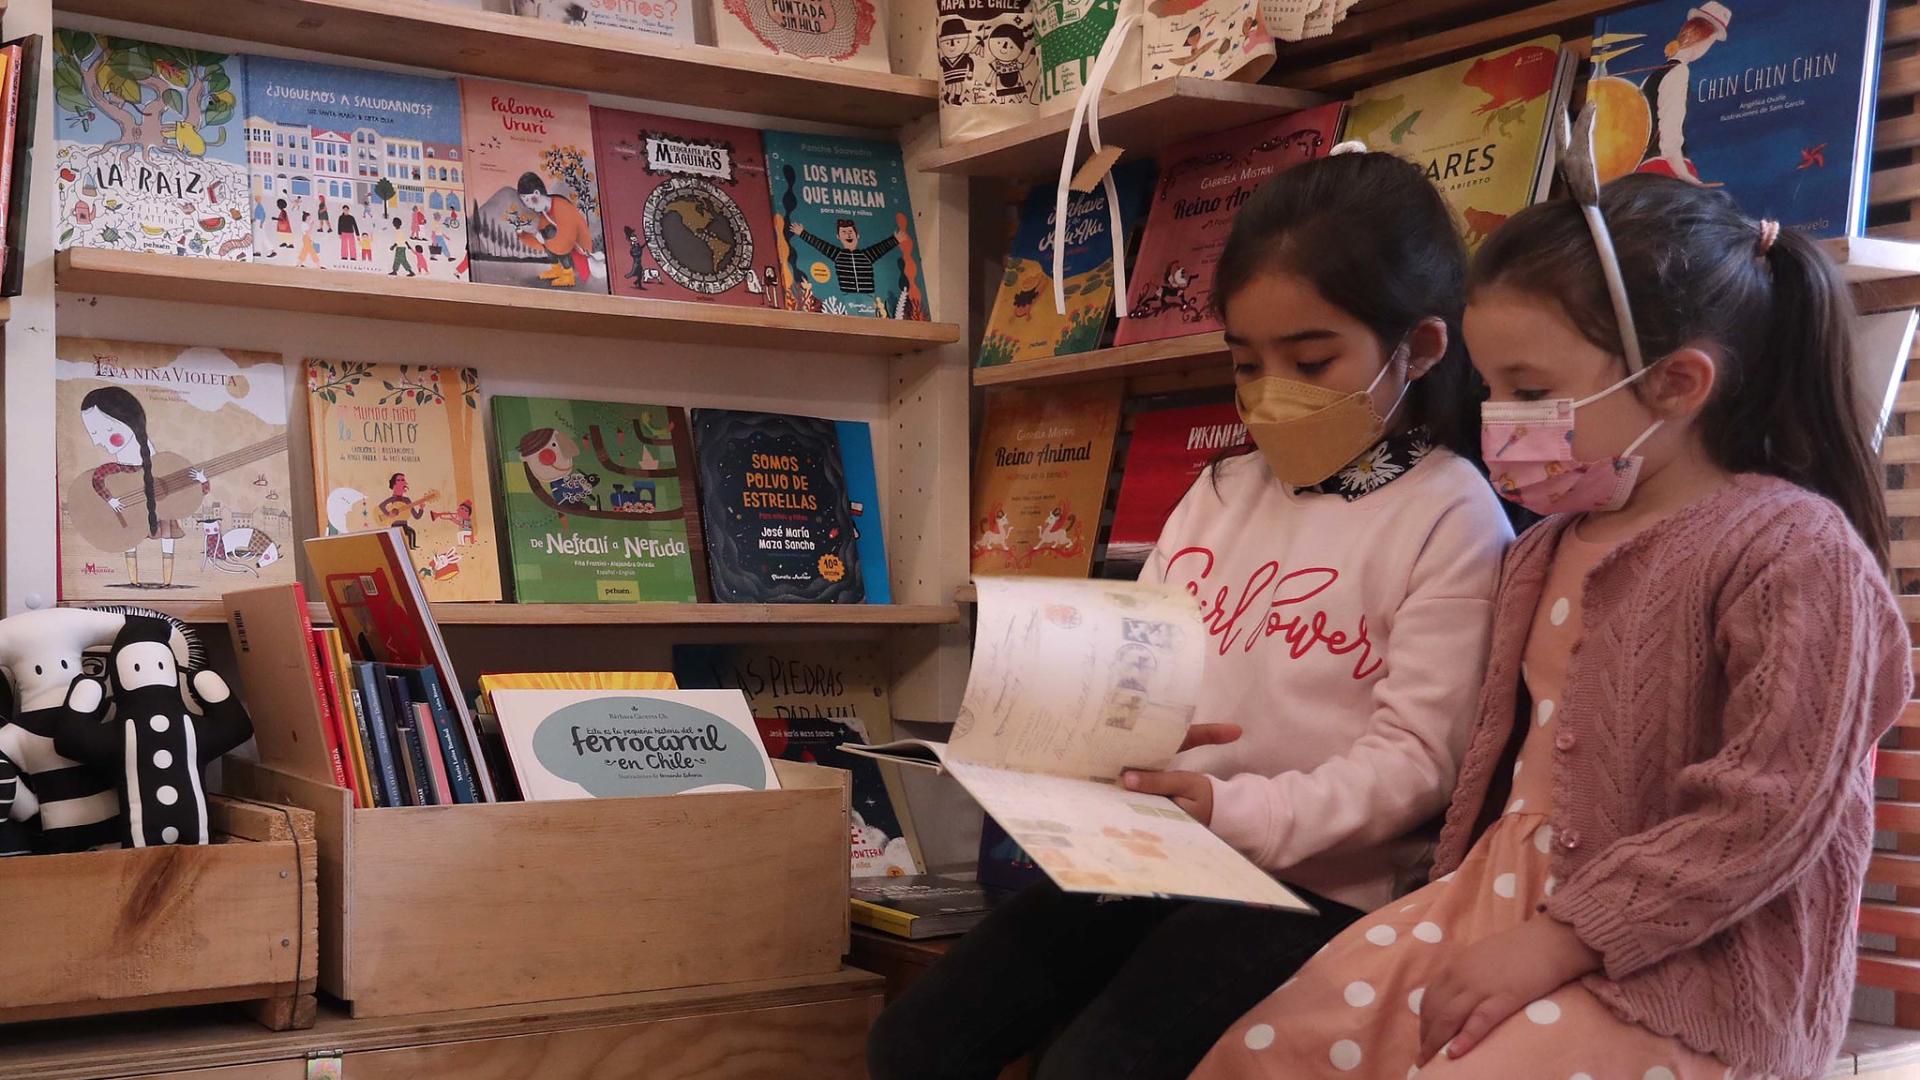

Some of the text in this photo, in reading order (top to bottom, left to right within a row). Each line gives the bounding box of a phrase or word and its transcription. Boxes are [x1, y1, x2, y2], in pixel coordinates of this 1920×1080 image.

[772, 0, 828, 19] PUNTADA
[940, 0, 1021, 11] MAPA DE CHILE
[781, 16, 821, 32] SIN HILO
[1698, 52, 1837, 102] CHIN CHIN CHIN
[266, 82, 433, 118] ¿JUGUEMOS A SALUDARNOS?
[491, 95, 555, 119] Paloma
[502, 114, 547, 135] Ururi
[1425, 144, 1496, 181] ARES
[97, 163, 123, 190] LA
[803, 164, 878, 187] LOS MARES
[1450, 177, 1490, 191] ABIERTO
[803, 185, 885, 209] QUE HABLAN
[1173, 195, 1222, 220] Reino
[173, 367, 237, 387] VIOLETA
[353, 405, 388, 420] MUNDO
[363, 420, 418, 443] CANTO
[751, 453, 799, 472] SOMOS
[995, 440, 1093, 467] Reino Animal
[746, 472, 808, 491] POLVO DE
[742, 492, 817, 511] ESTRELLAS
[761, 525, 810, 538] José María
[530, 533, 686, 558] De Neftalí a Neruda
[758, 539, 816, 551] Maza Sancho
[1245, 567, 1383, 680] Power
[768, 656, 844, 698] PIEDRAS
[571, 725, 727, 756] ferrocarril
[332, 748, 346, 788] NCLINADA
[618, 752, 695, 770] en Chile
